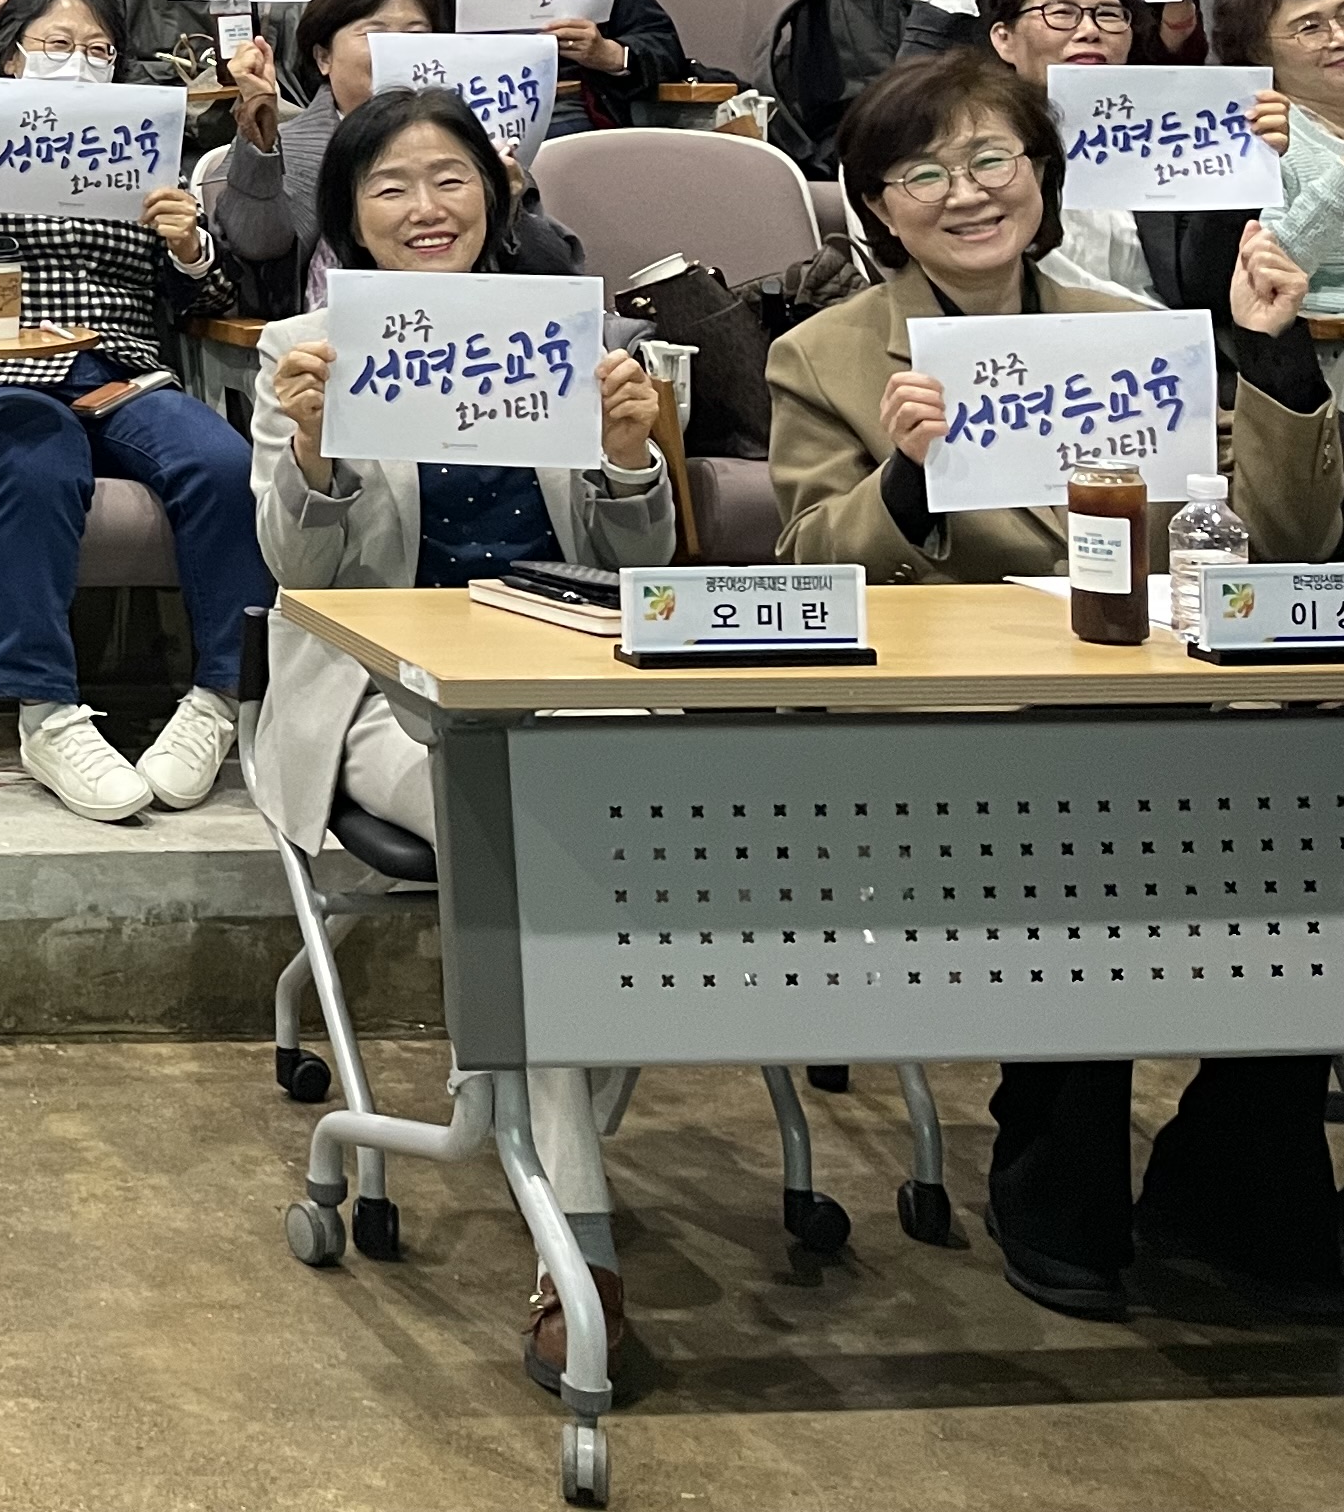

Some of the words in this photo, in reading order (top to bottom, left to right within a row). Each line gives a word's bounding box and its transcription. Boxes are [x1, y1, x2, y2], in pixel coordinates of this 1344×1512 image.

[412, 60, 446, 83] 광주
[471, 66, 539, 122] 등교육
[1091, 94, 1135, 118] 광주
[20, 107, 58, 132] 광주
[1067, 101, 1251, 163] 성평등교육
[382, 309, 434, 343] 광주
[349, 321, 573, 402] 성평등교육
[972, 352, 1028, 387] 광주
[945, 357, 1184, 448] 성평등교육
